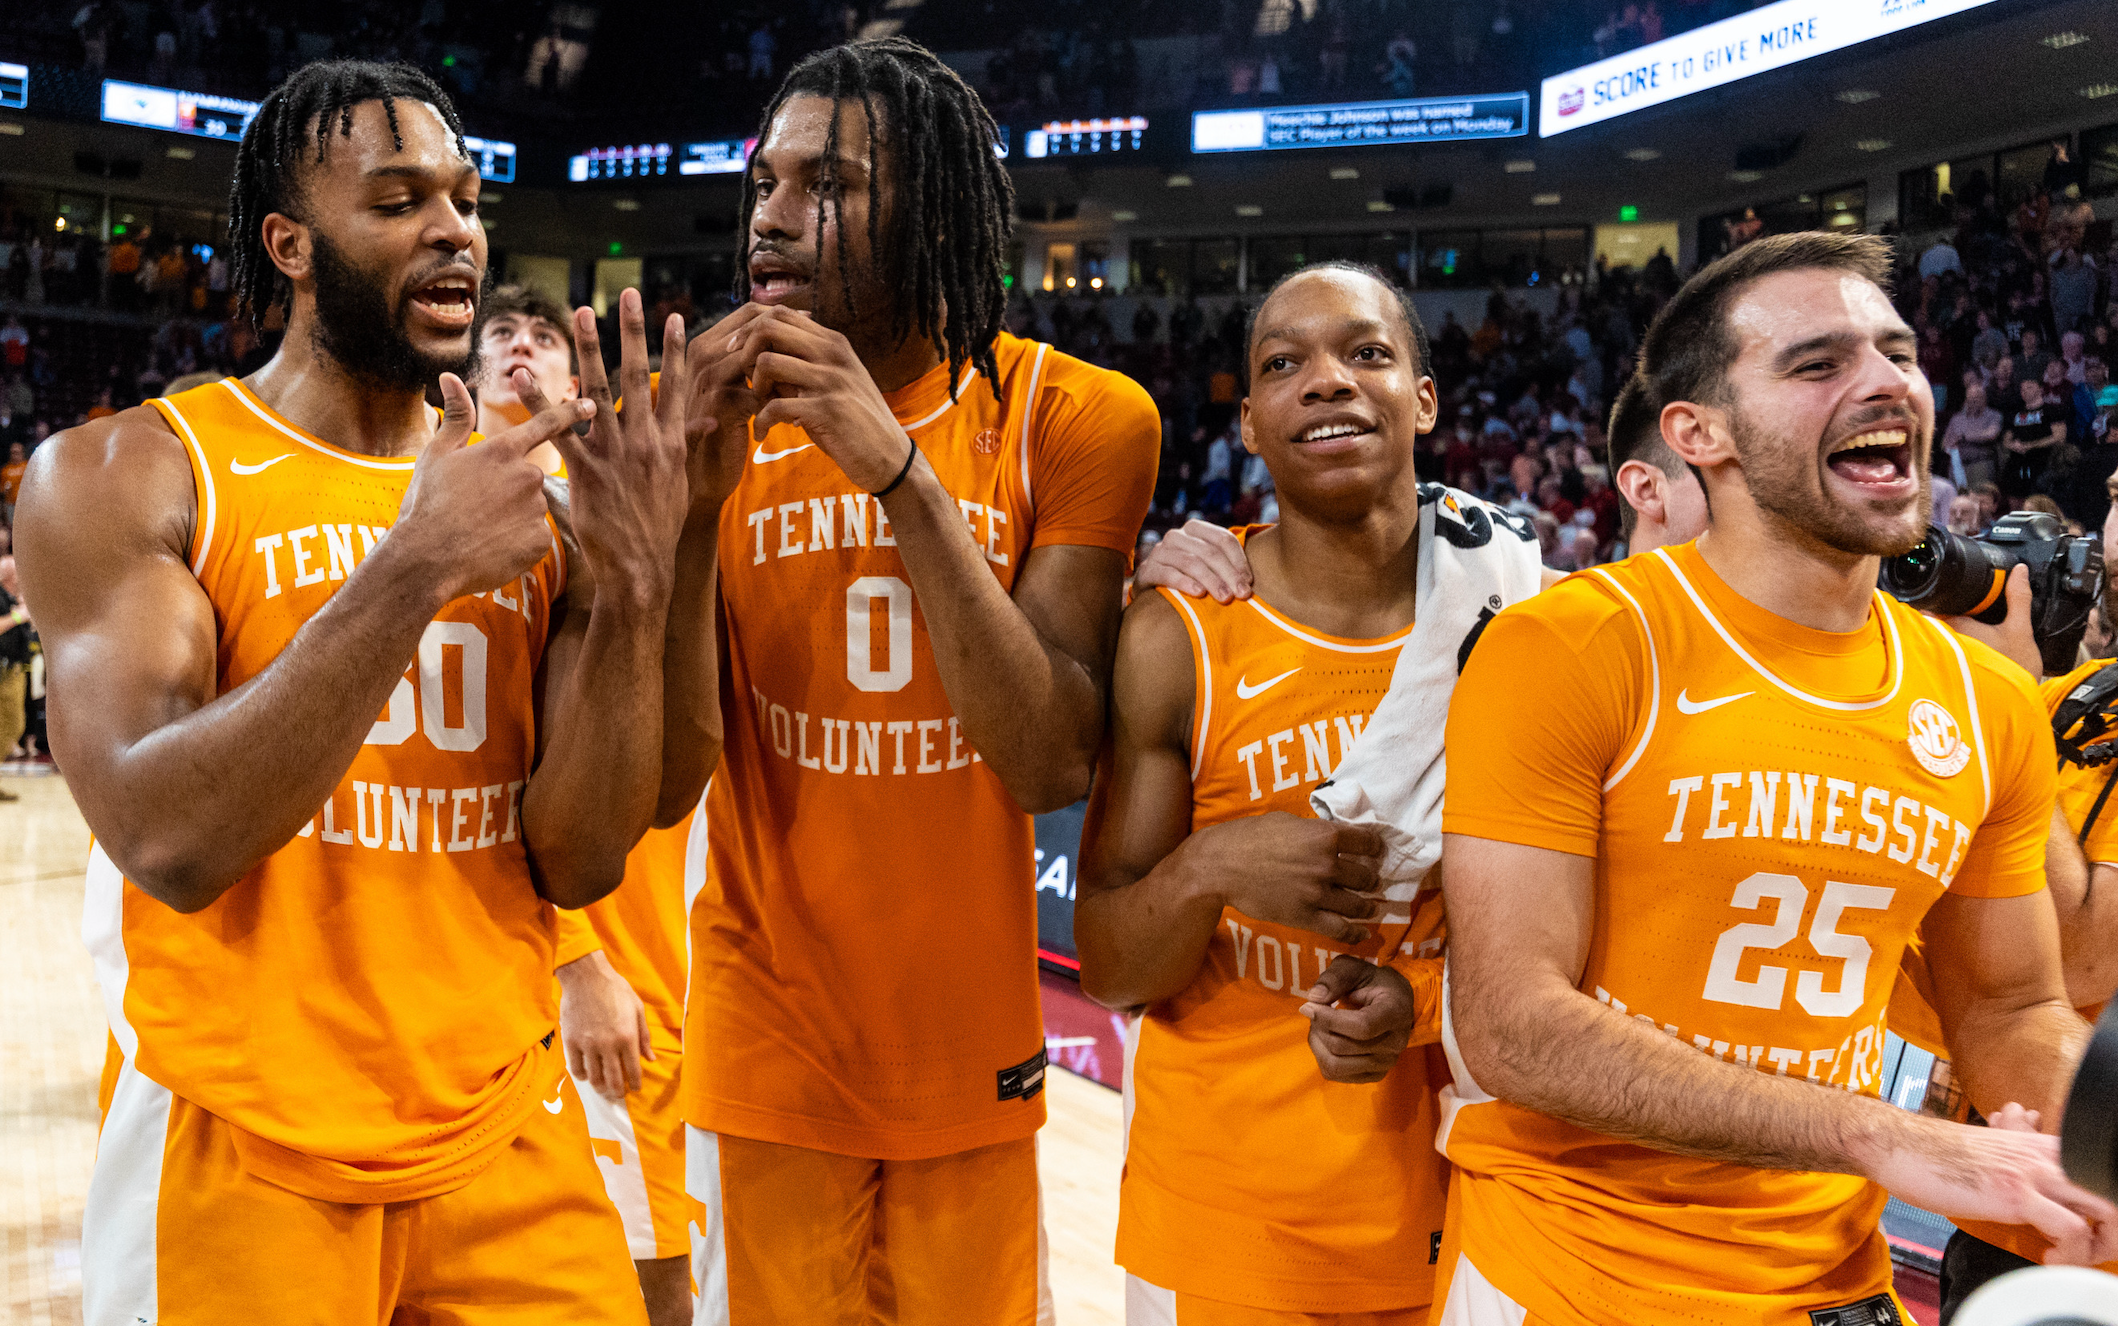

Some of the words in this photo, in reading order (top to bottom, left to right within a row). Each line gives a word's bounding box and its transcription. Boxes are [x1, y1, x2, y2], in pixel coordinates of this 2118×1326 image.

[1593, 62, 1661, 106] SCORE
[1672, 57, 1694, 81] TO
[1703, 40, 1748, 72] GIVE
[1760, 17, 1818, 54] MORE
[975, 430, 1000, 453] SEC
[1992, 525, 2022, 535] Canon
[846, 576, 913, 692] 0
[1912, 702, 1956, 756] SEC
[1662, 770, 1971, 889] TENNESSEE
[1701, 871, 1897, 1018] 25
